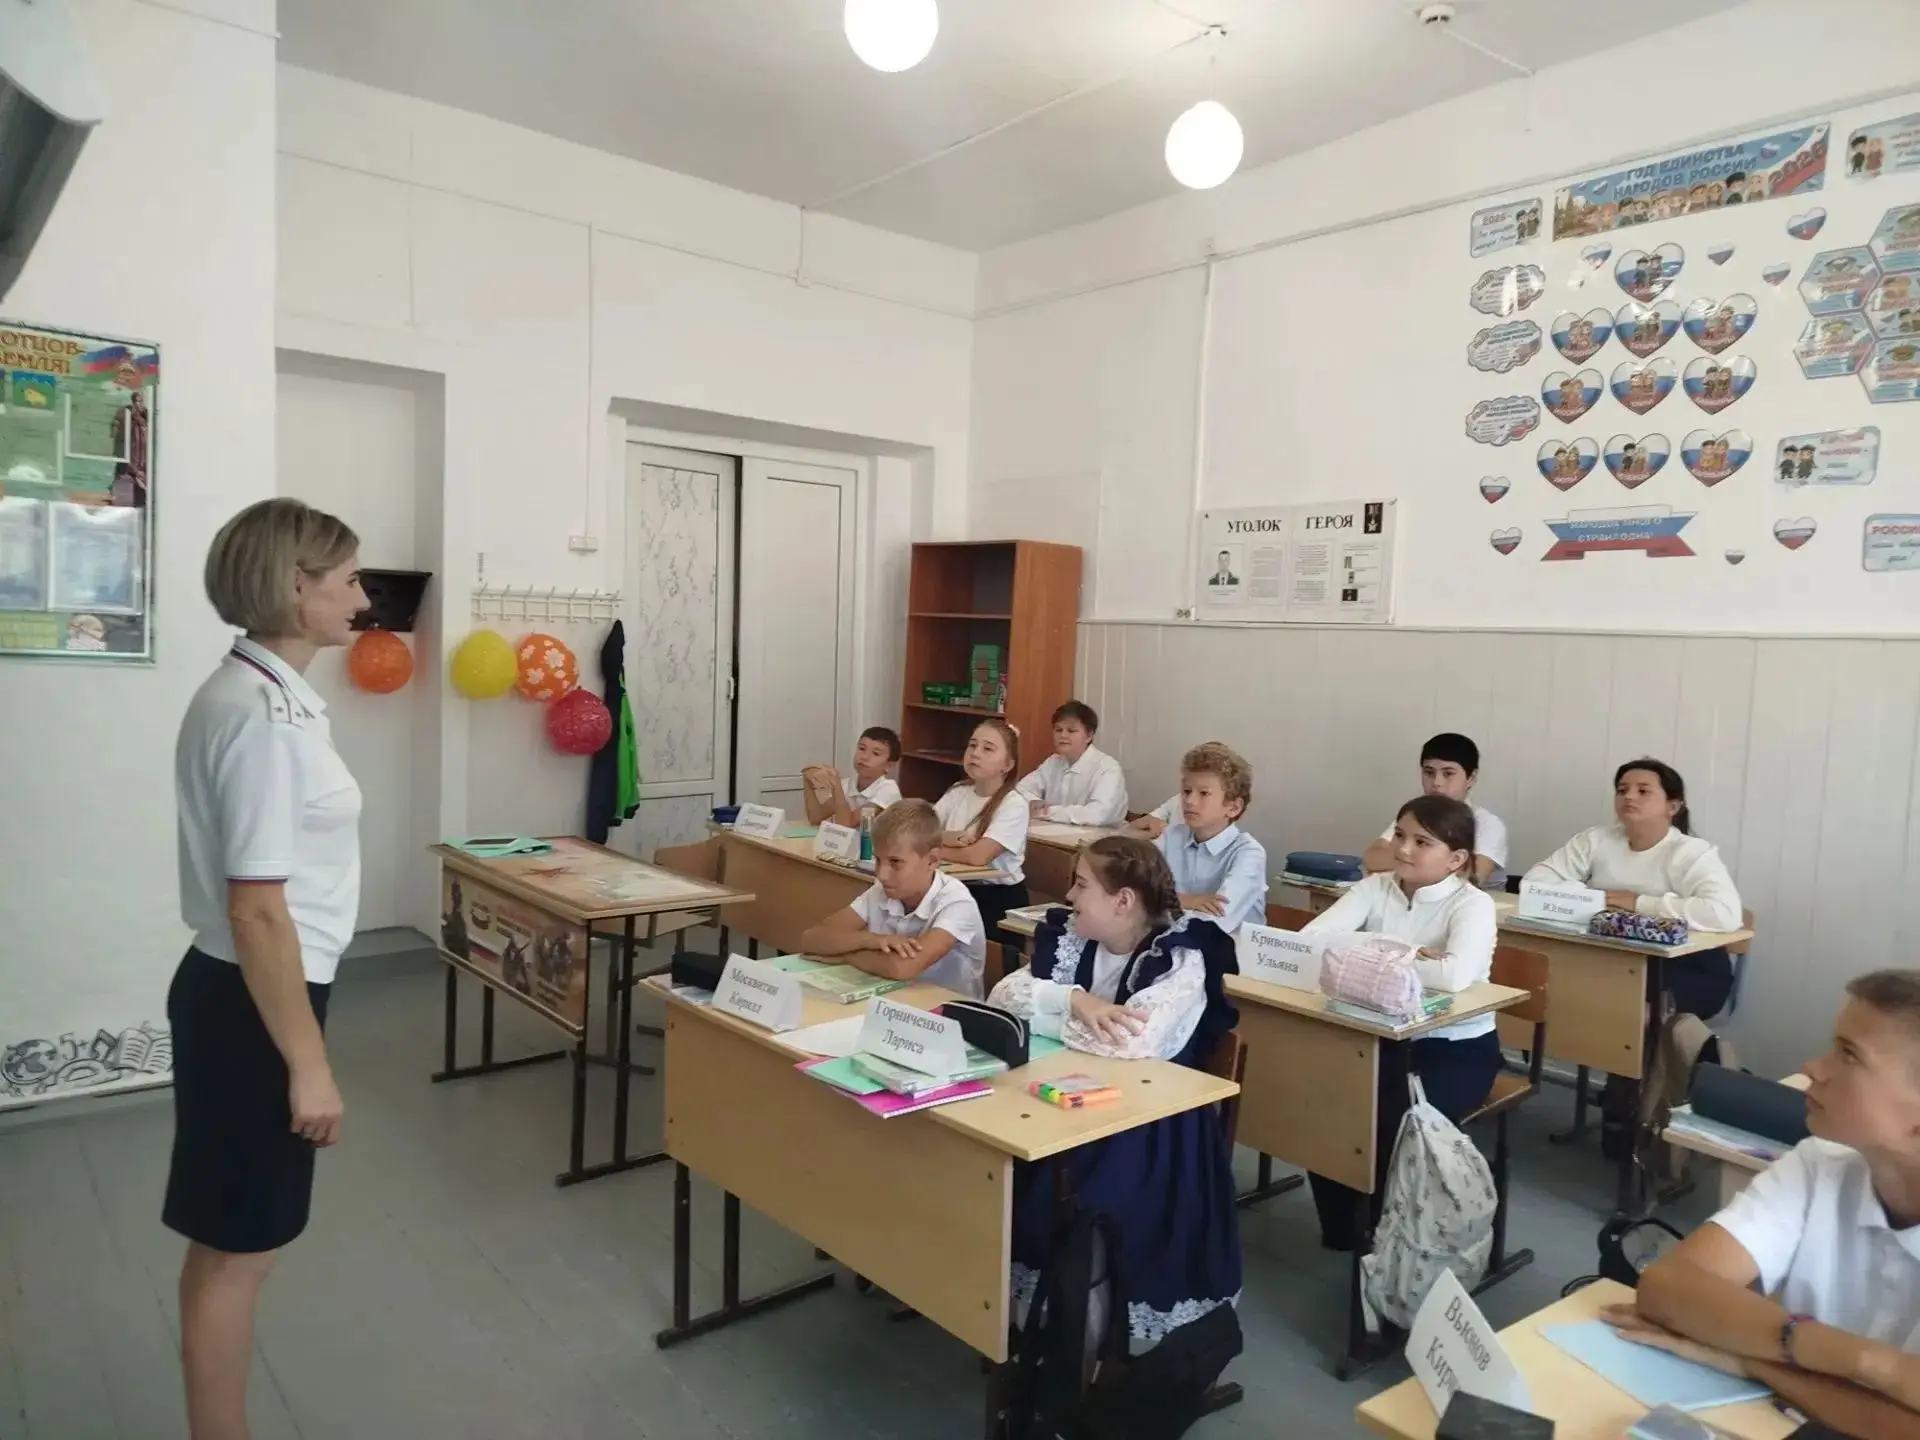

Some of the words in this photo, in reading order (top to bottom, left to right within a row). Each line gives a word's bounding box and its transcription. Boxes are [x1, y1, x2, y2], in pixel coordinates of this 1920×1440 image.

[1227, 518, 1282, 533] УГОЛОК
[1305, 514, 1354, 529] ГЕРОЯ
[1256, 952, 1300, 973] Ульяна
[875, 1000, 945, 1033] Горниченко
[882, 1028, 924, 1054] Лариса
[1444, 1296, 1492, 1372] Вьюнов
